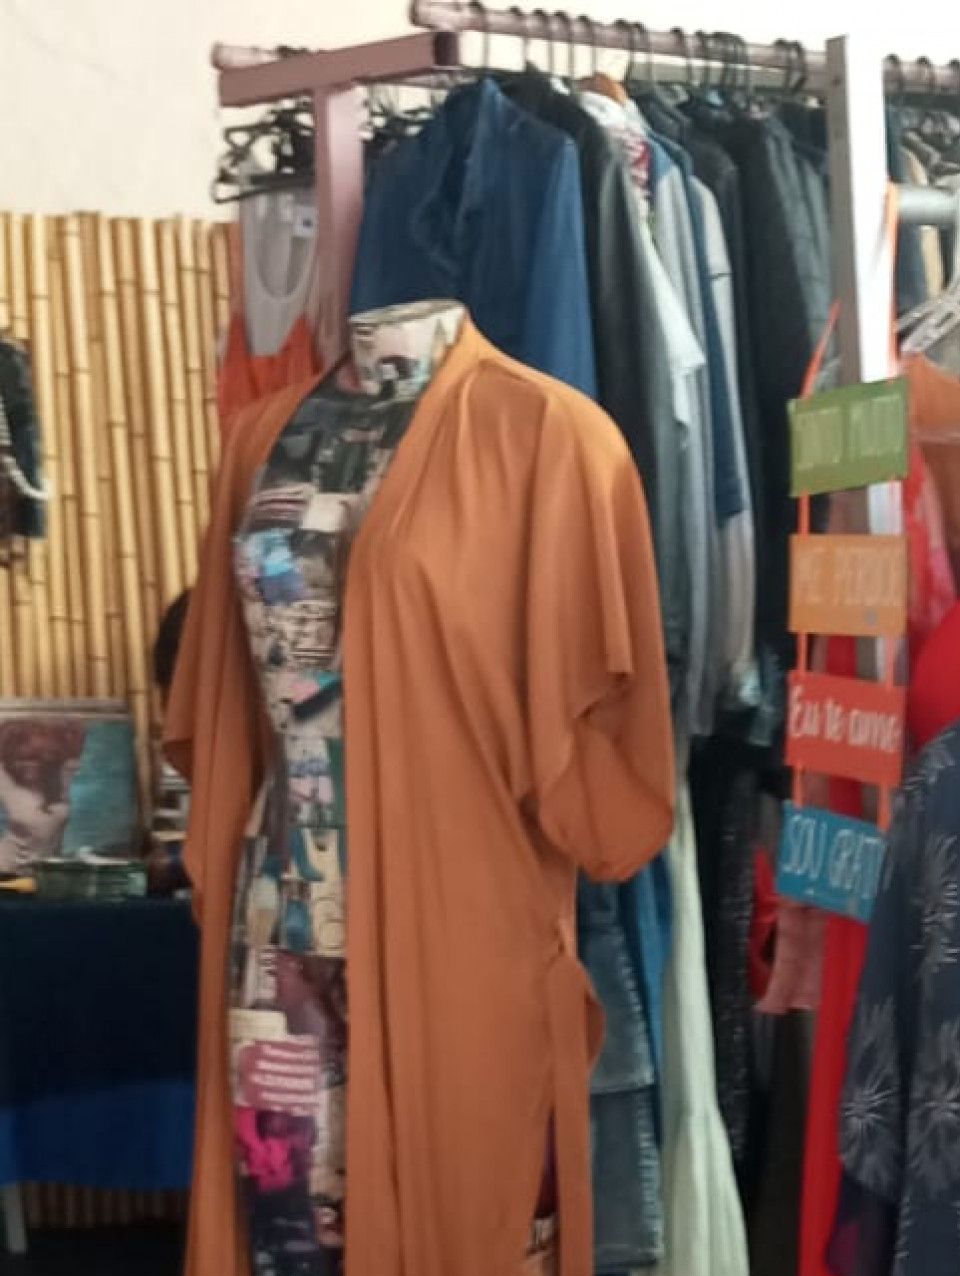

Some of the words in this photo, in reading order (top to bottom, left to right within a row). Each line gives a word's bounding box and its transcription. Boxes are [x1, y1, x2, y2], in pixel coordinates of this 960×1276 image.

[788, 684, 820, 739] Eu
[824, 698, 844, 743] te
[780, 813, 829, 880] SOU
